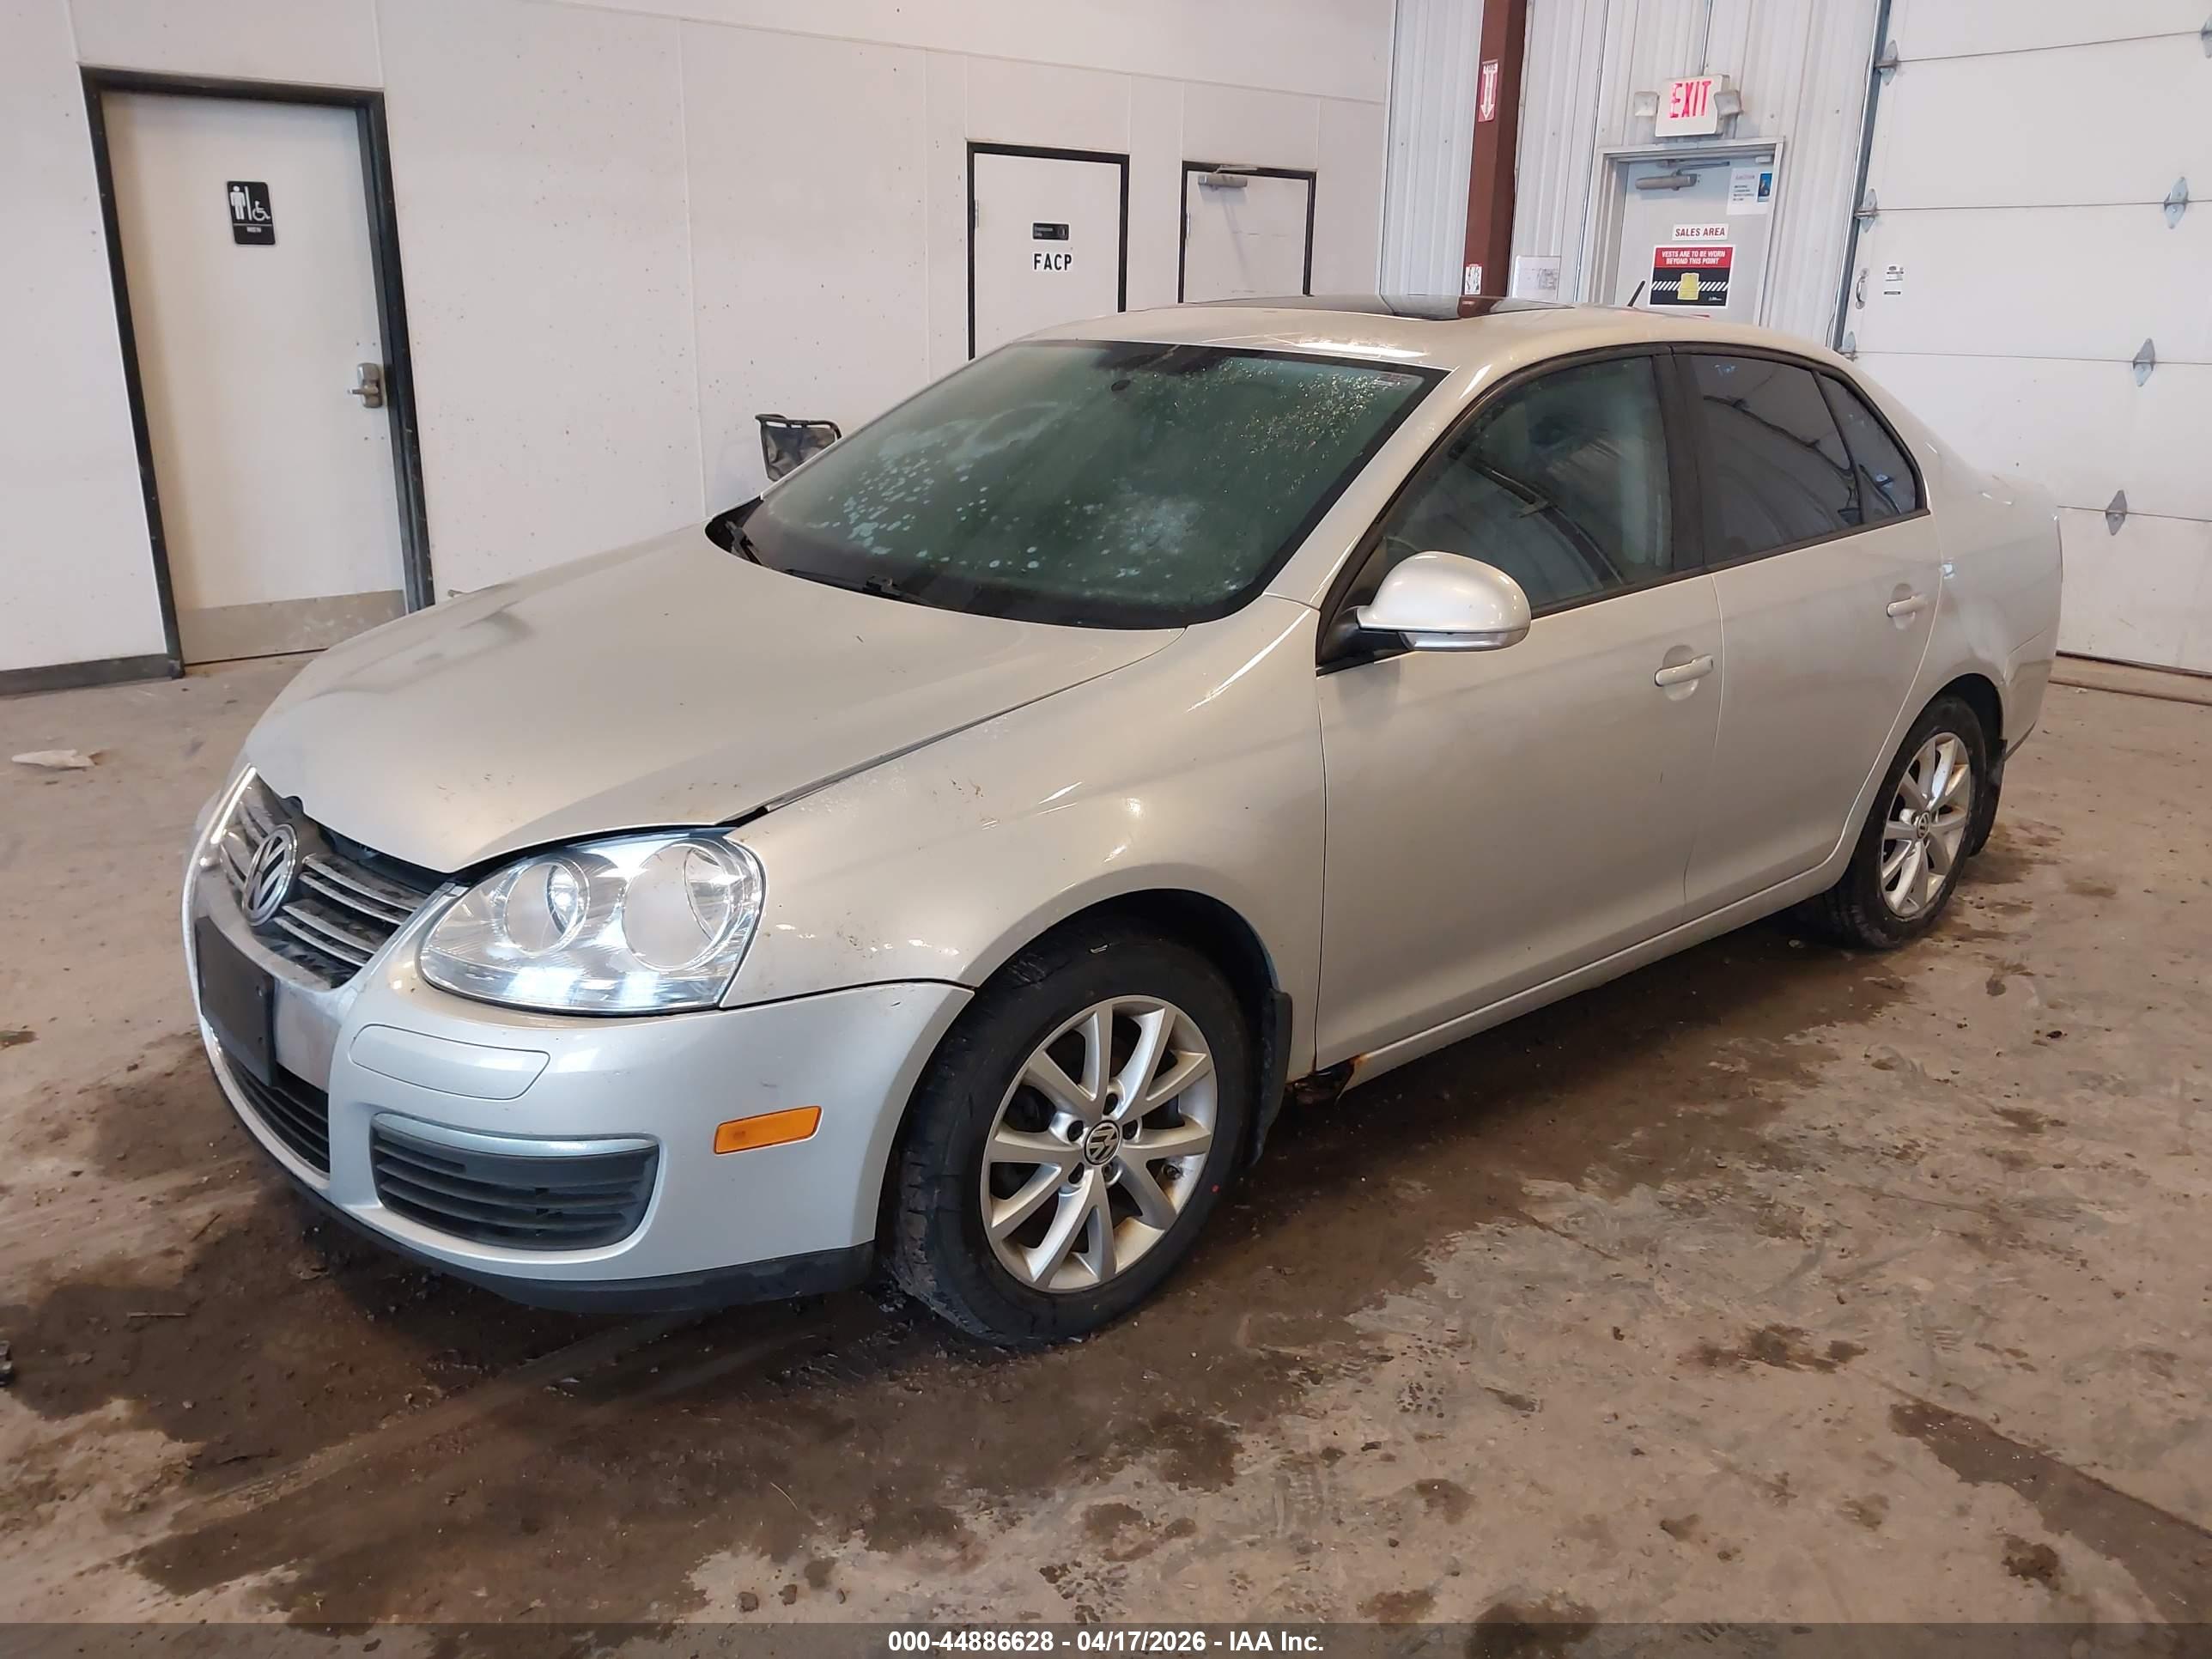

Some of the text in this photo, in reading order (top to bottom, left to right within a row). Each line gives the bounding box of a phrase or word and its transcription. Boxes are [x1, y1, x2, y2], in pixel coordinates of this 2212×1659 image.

[1669, 81, 1711, 118] EXIT
[1674, 227, 1725, 237] SALES AREA
[1034, 252, 1073, 270] FACP
